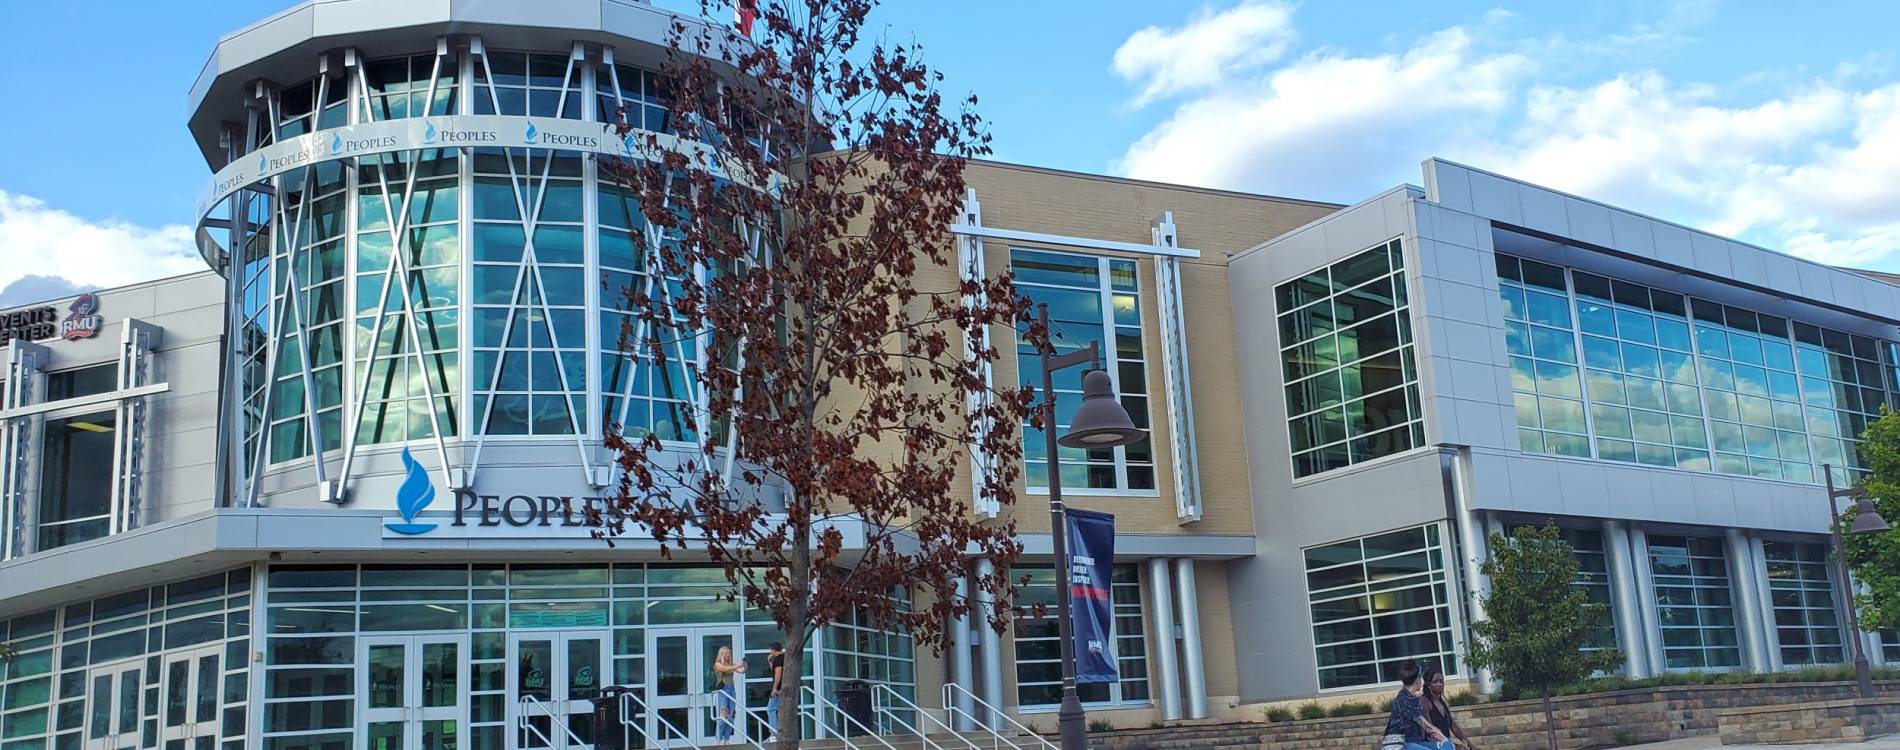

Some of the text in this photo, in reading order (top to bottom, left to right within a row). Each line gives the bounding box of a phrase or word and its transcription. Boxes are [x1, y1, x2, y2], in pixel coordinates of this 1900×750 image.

[346, 136, 396, 152] PEOPLES
[441, 130, 496, 142] PEOPLES
[543, 132, 597, 148] PEOPLES
[270, 151, 309, 171] PEOPLES
[63, 316, 97, 336] RMU
